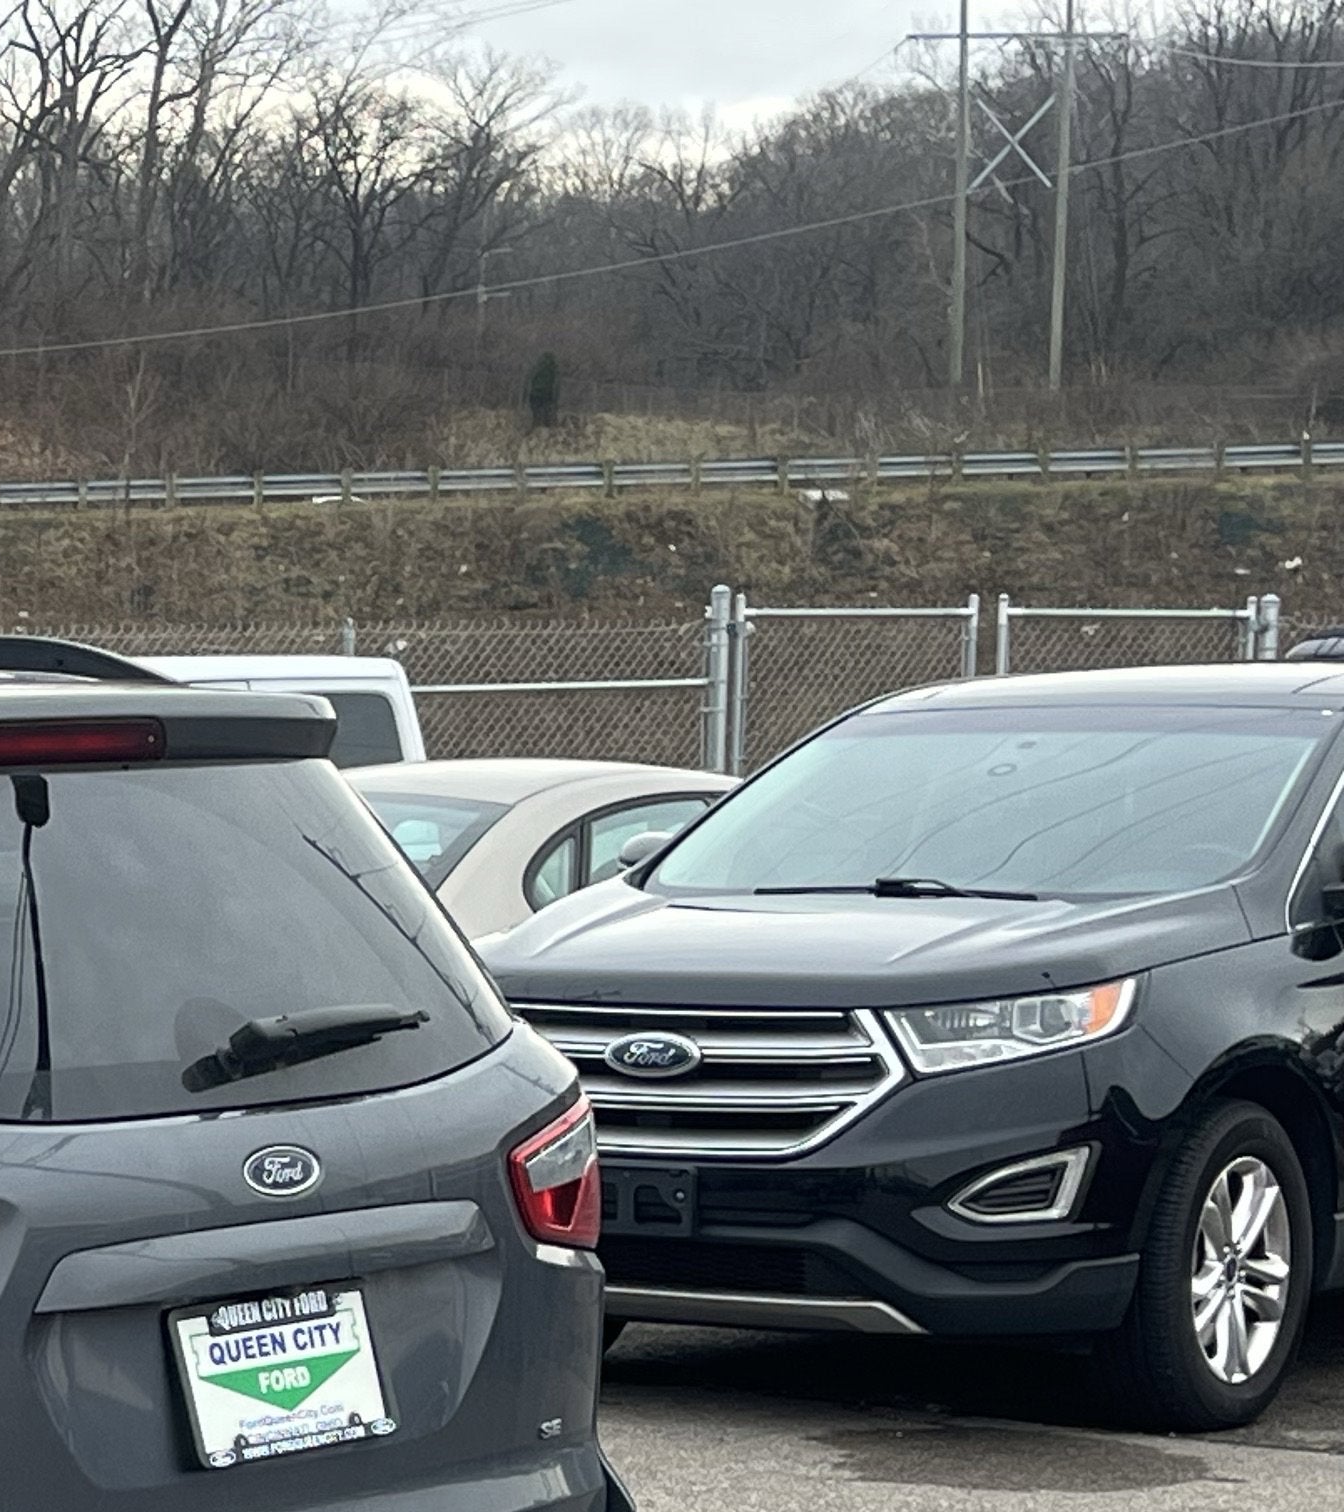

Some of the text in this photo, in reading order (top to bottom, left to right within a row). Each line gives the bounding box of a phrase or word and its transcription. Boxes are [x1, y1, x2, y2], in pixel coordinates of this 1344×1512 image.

[623, 1042, 676, 1065] Ford
[263, 1156, 303, 1184] Ford
[218, 1290, 328, 1331] QUEEN CITY FORD
[208, 1321, 341, 1366] QUEEN CITY
[258, 1365, 310, 1394] FORD
[540, 1417, 562, 1440] SE
